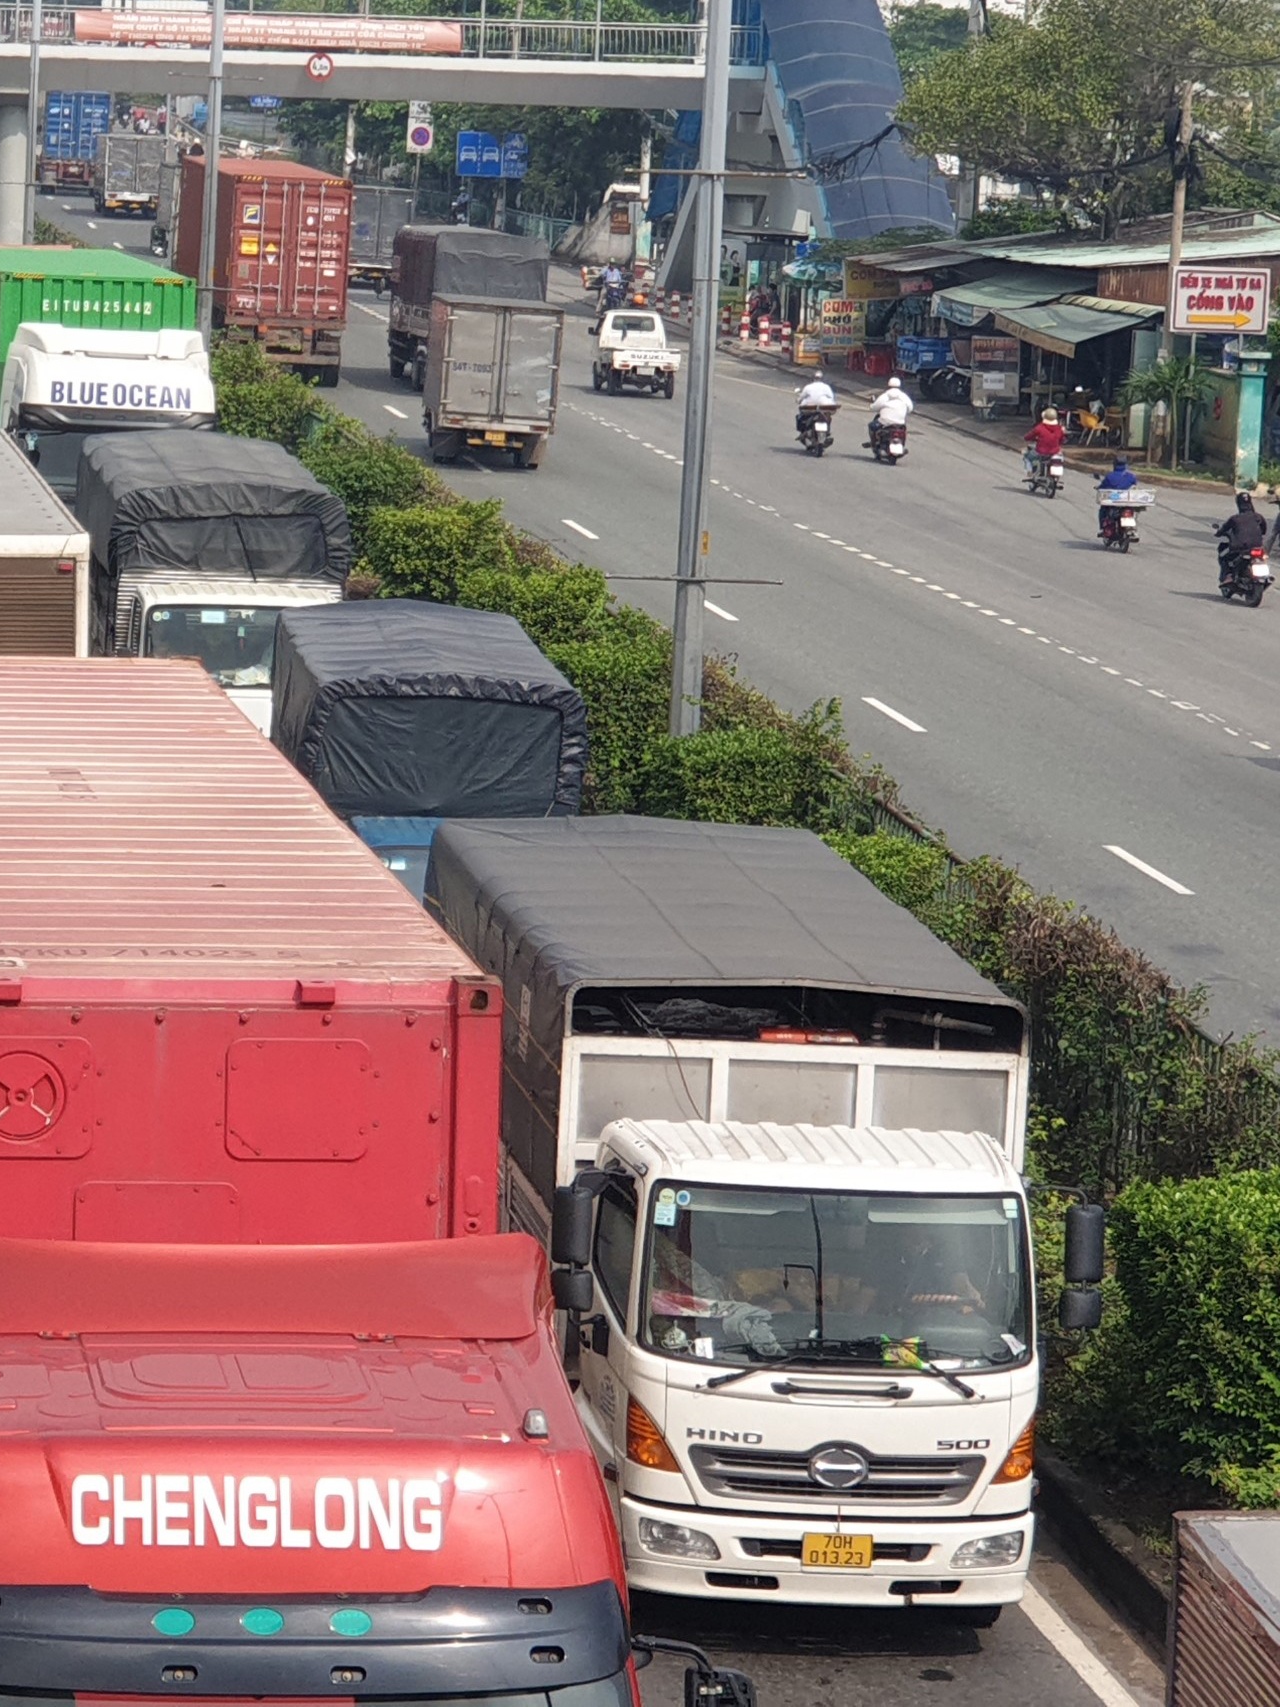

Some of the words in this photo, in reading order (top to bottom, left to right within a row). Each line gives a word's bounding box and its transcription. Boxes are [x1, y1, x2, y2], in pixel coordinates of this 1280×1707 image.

[1228, 292, 1254, 312] VÀO
[50, 380, 109, 407] BLUE
[112, 383, 191, 410] OCEAN
[686, 1427, 763, 1445] HINO
[937, 1438, 991, 1457] 500
[71, 1473, 443, 1552] CHENGLONG
[823, 1535, 853, 1549] 70H
[809, 1550, 864, 1566] 013.23
